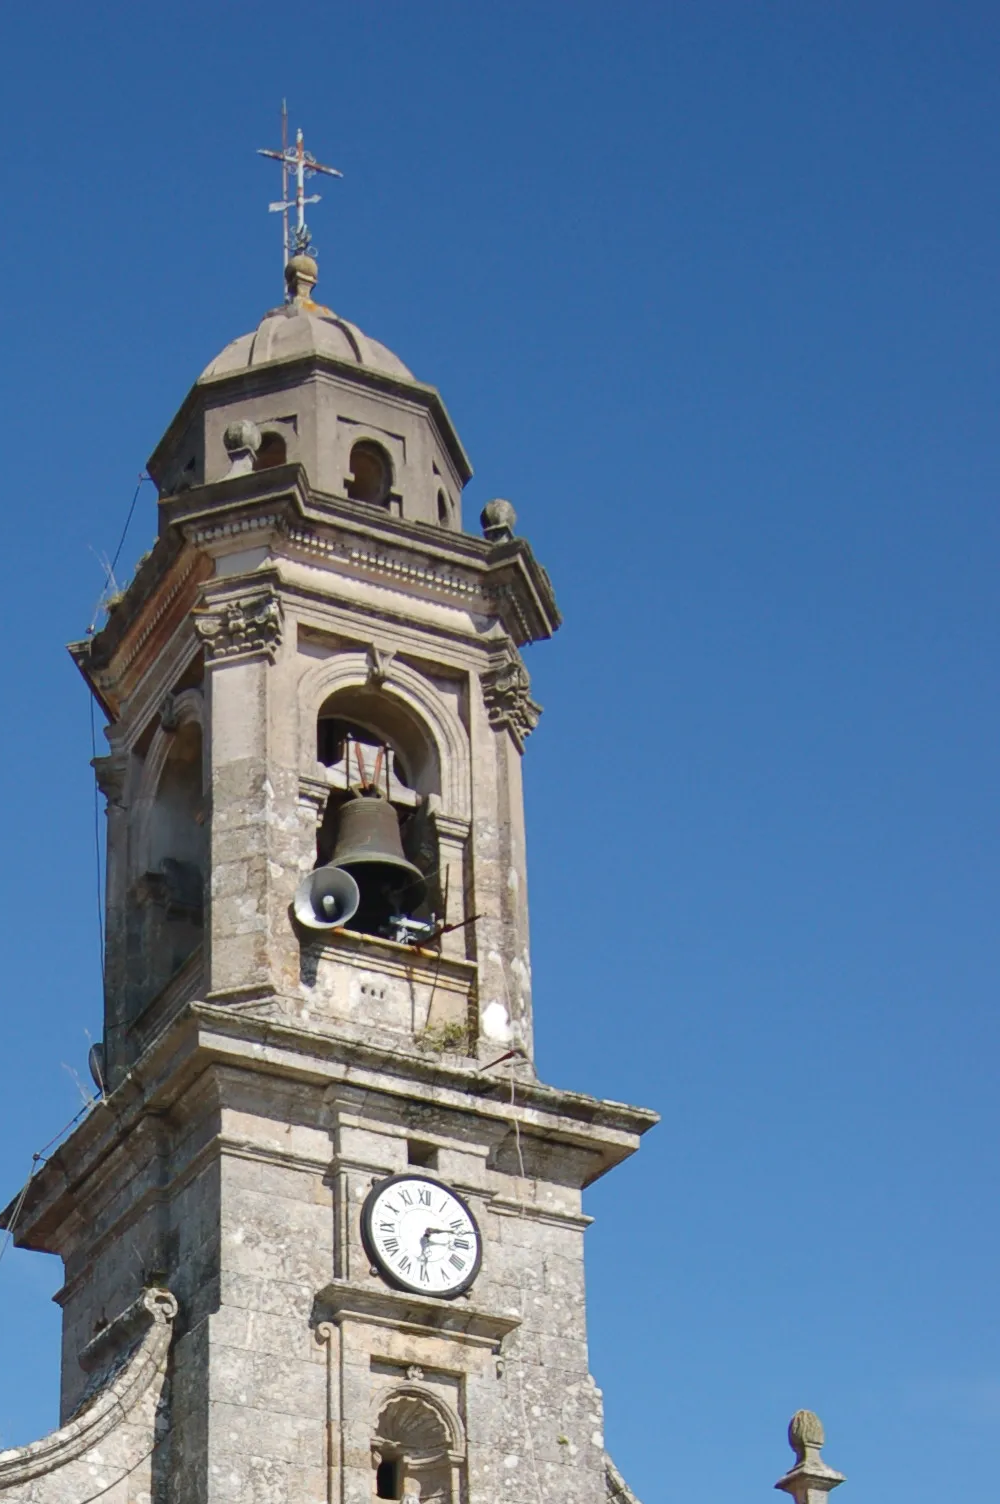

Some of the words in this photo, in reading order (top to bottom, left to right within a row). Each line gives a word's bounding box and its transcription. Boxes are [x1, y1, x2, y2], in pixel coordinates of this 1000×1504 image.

[397, 1189, 413, 1206] XI
[417, 1188, 432, 1206] XII
[384, 1201, 400, 1216] X
[438, 1200, 448, 1213] I
[379, 1219, 395, 1233] IX
[449, 1219, 464, 1229] II
[382, 1237, 400, 1257] VIII
[454, 1238, 469, 1250] III
[397, 1255, 412, 1274] VII
[440, 1267, 450, 1282] V
